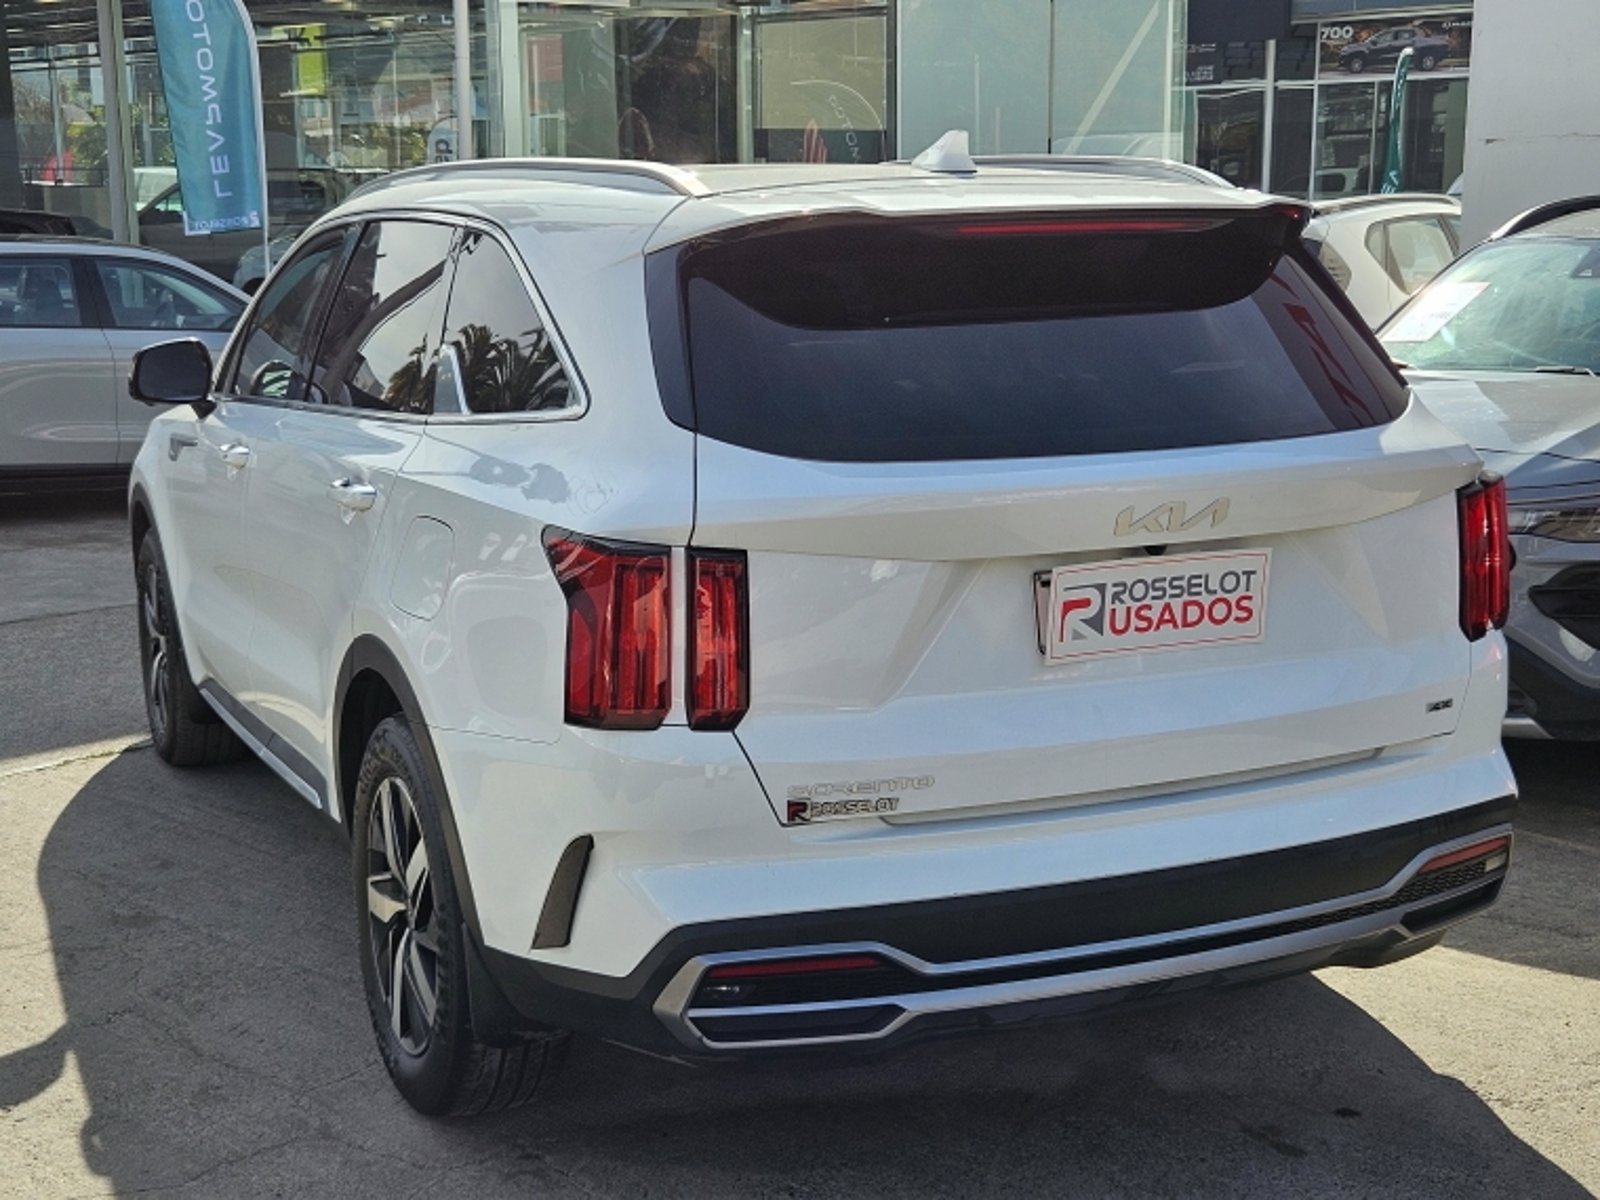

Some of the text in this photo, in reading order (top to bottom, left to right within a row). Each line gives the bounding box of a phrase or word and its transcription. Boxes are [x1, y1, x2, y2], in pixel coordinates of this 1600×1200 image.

[1320, 26, 1353, 40] 700
[1114, 497, 1230, 537] KIA
[1111, 570, 1257, 605] ROSSELOT
[1109, 595, 1254, 636] USADOS
[787, 775, 935, 798] SORENTO
